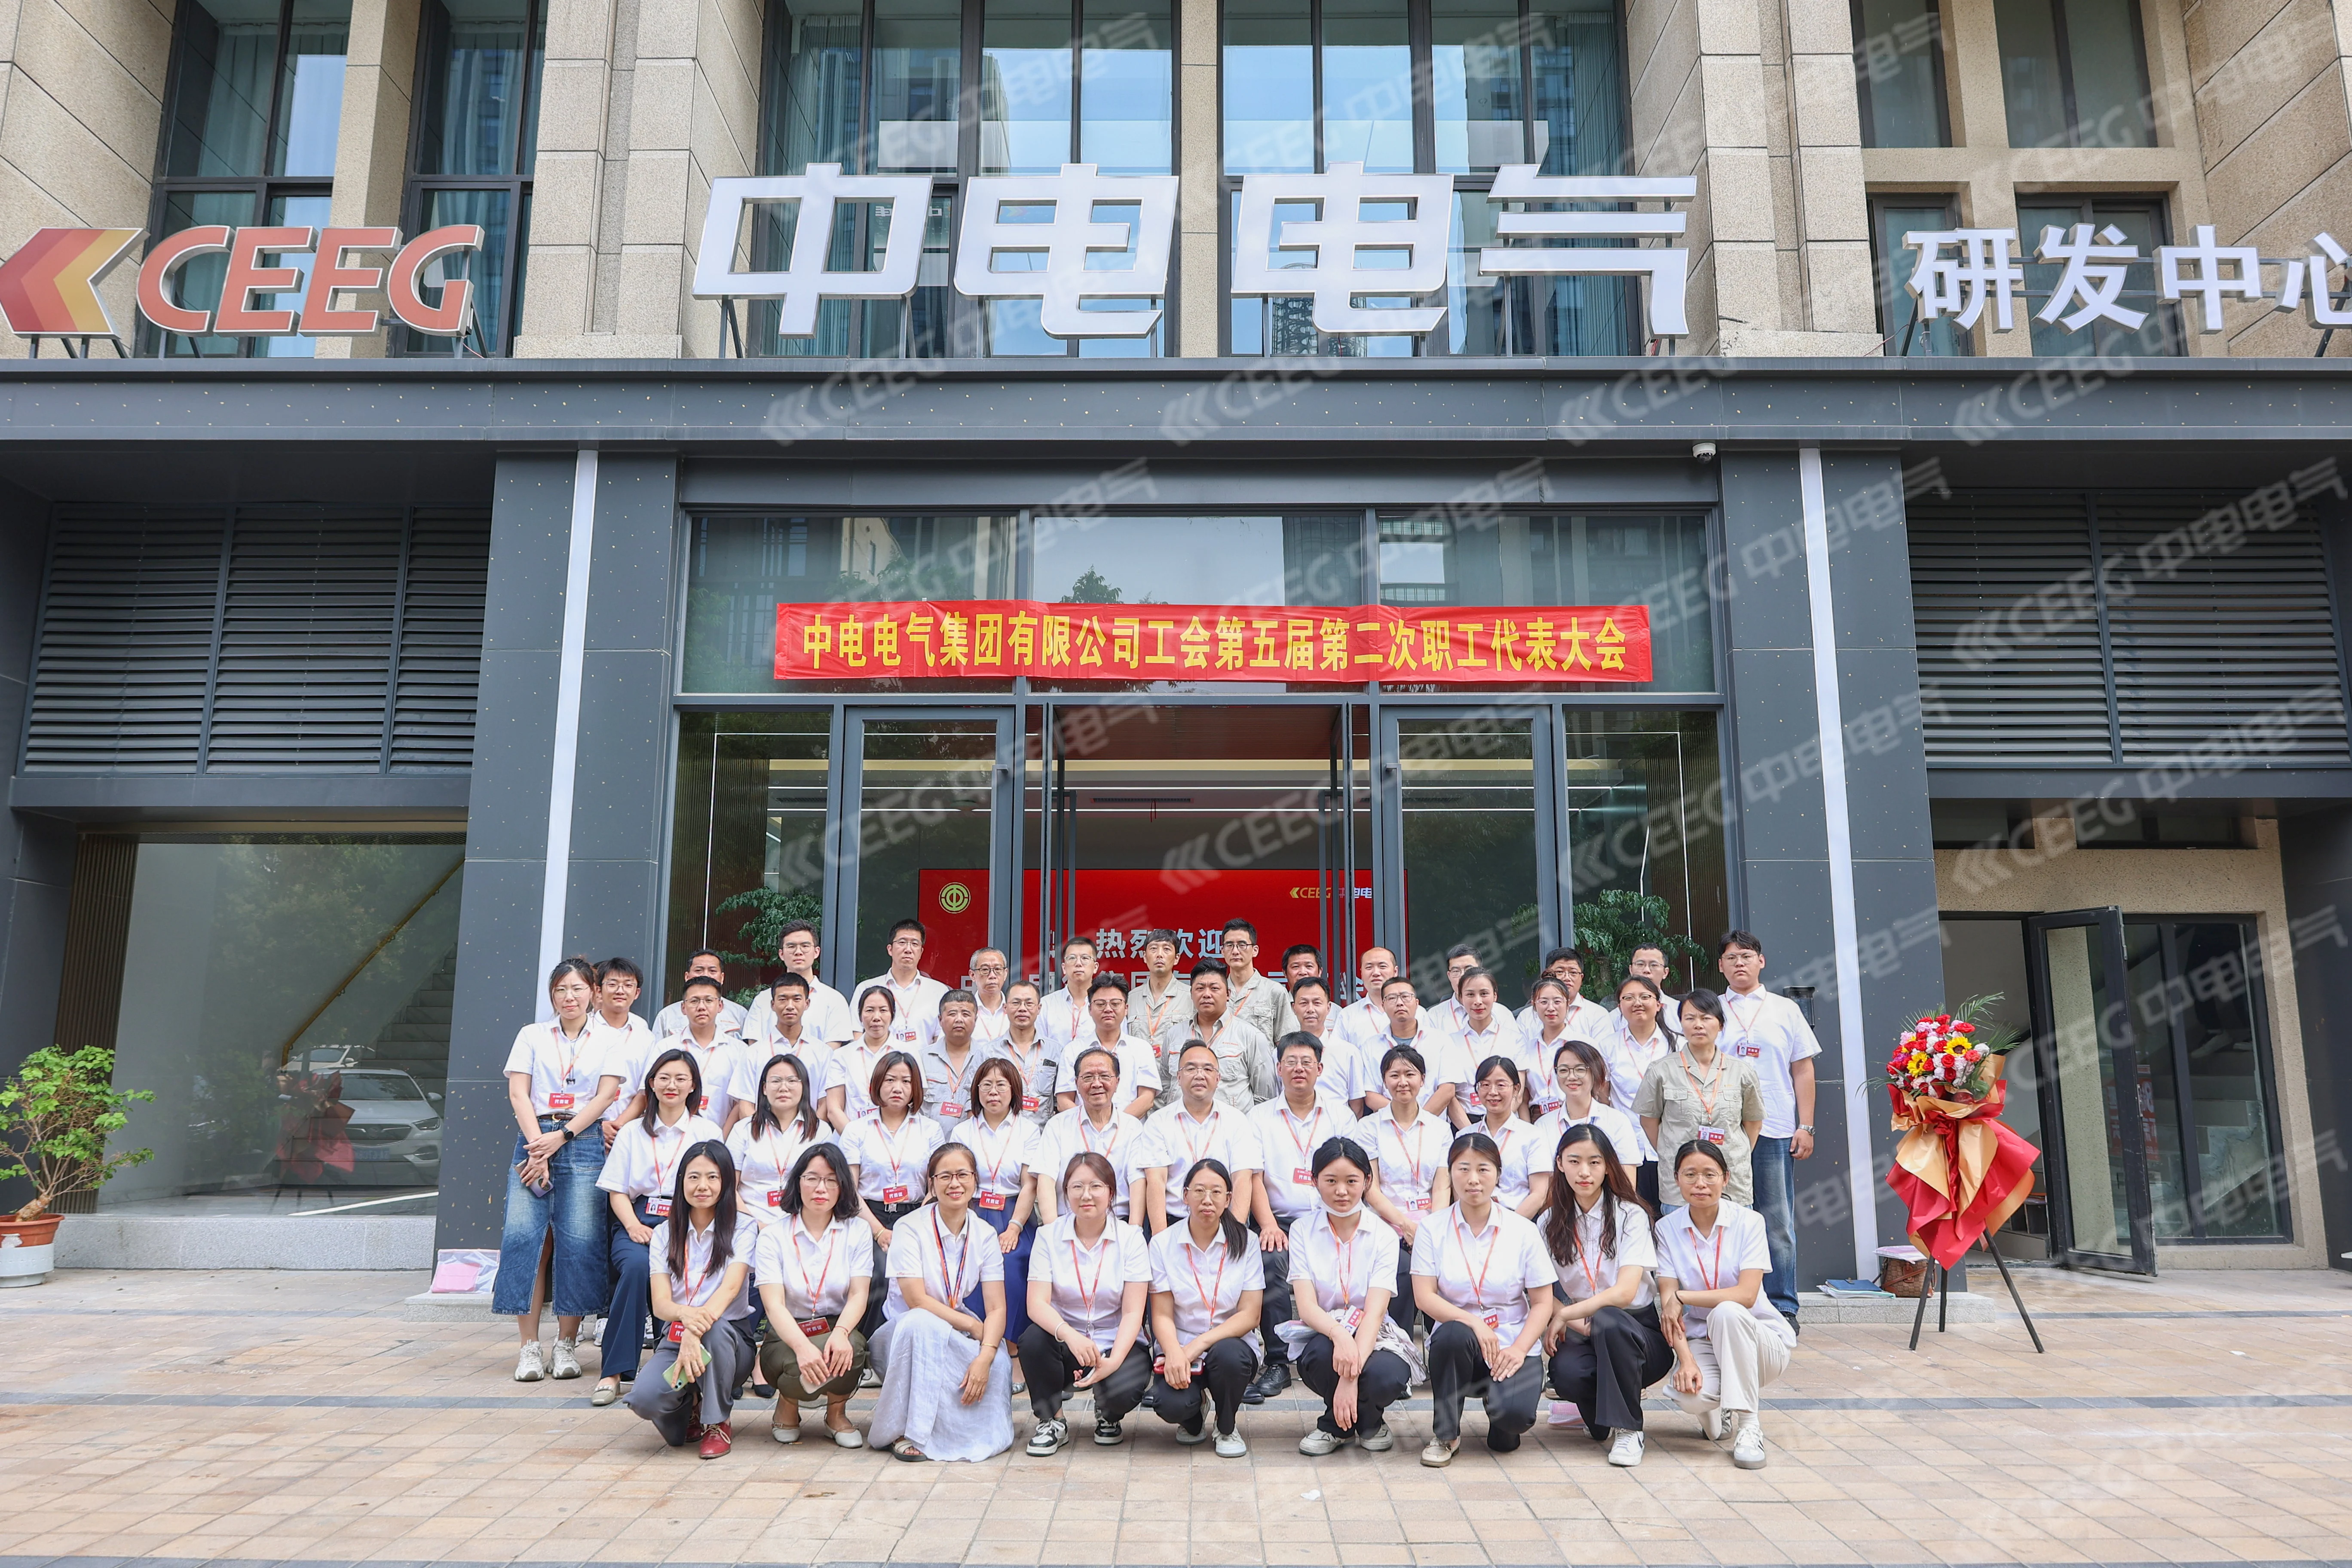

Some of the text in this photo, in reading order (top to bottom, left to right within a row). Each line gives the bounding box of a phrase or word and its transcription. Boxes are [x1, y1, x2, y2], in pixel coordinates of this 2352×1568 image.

[137, 224, 485, 337] CEEG
[692, 162, 1697, 338] 中电电气
[1903, 223, 2352, 335] 研发中心
[802, 610, 1626, 672] 中电电气集团有限公司工会第五届第二次职工代表大会
